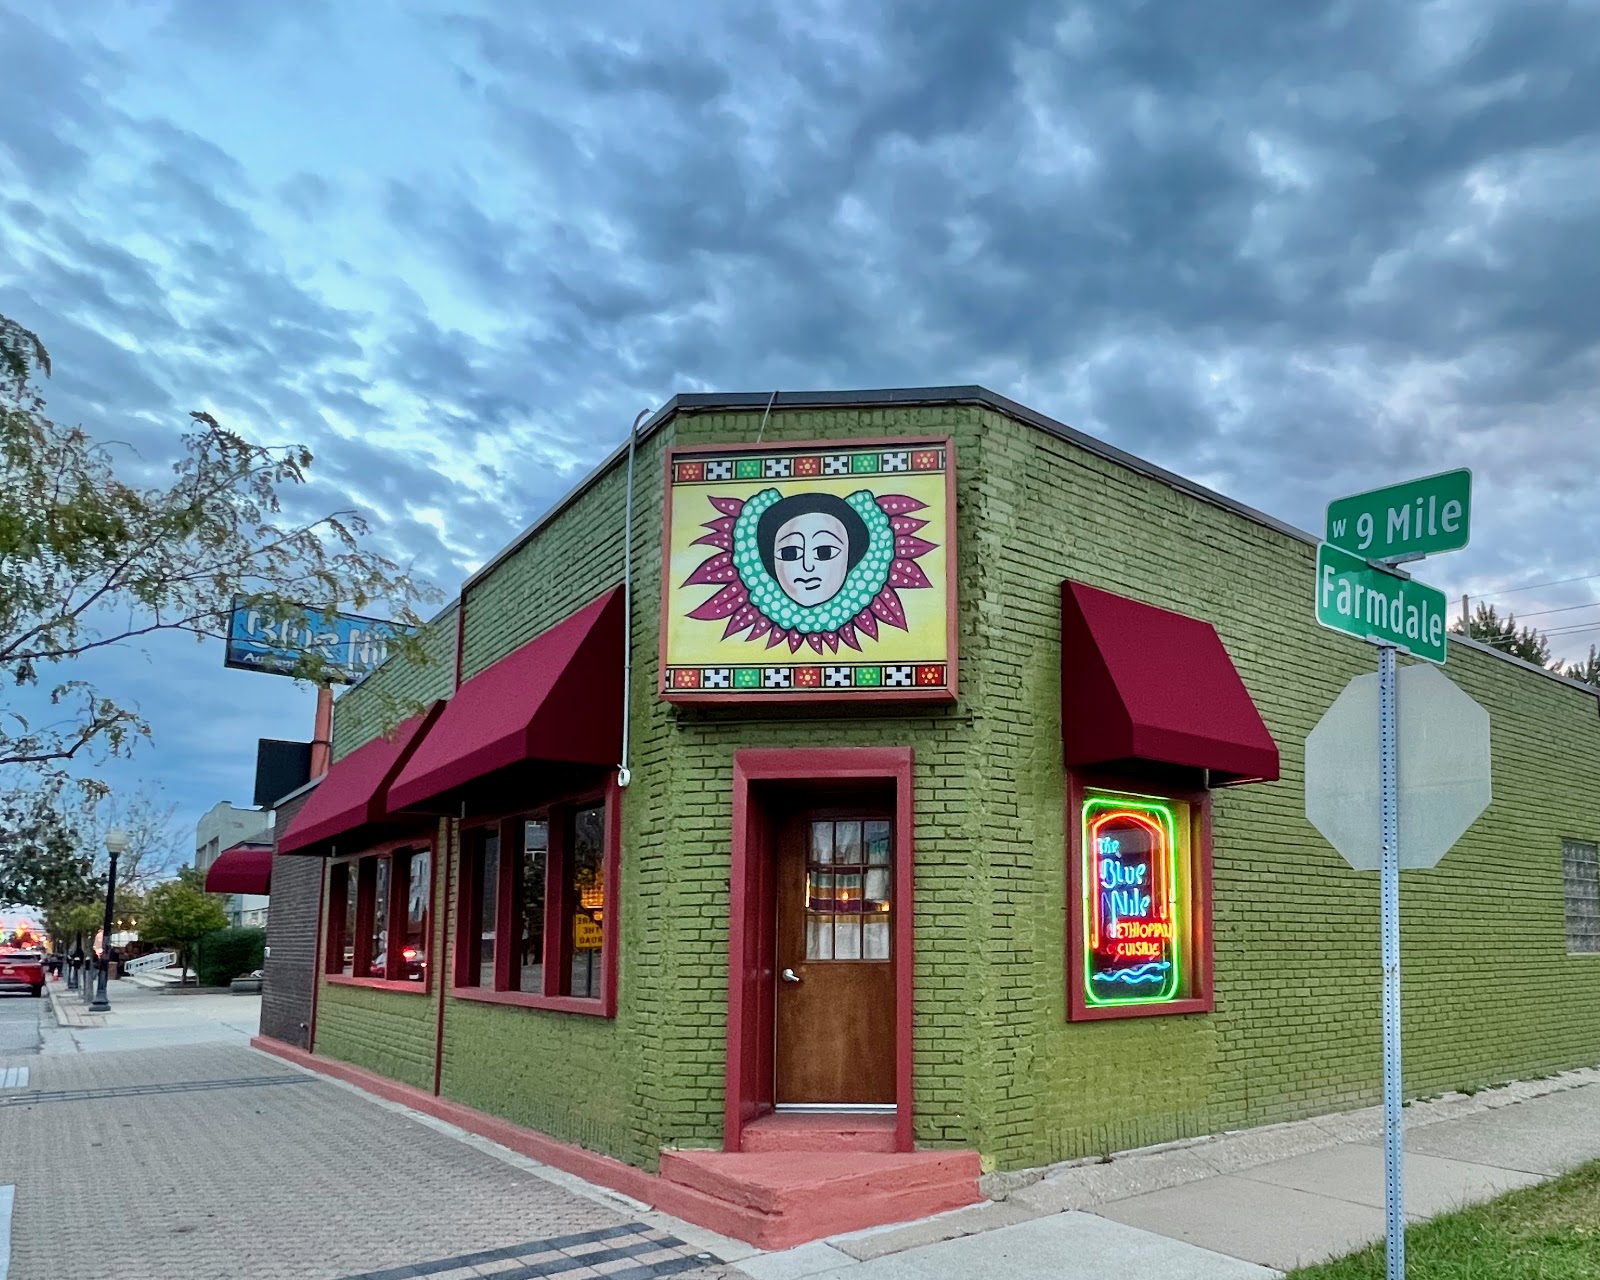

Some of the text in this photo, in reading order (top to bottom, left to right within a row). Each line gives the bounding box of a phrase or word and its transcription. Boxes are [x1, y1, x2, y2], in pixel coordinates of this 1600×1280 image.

[1333, 495, 1462, 550] W 9 Mile
[1322, 564, 1442, 647] Farmdale
[1111, 887, 1151, 938] Nile
[1116, 921, 1173, 939] ETHIOPIAN
[1117, 941, 1160, 956] CUISINE
